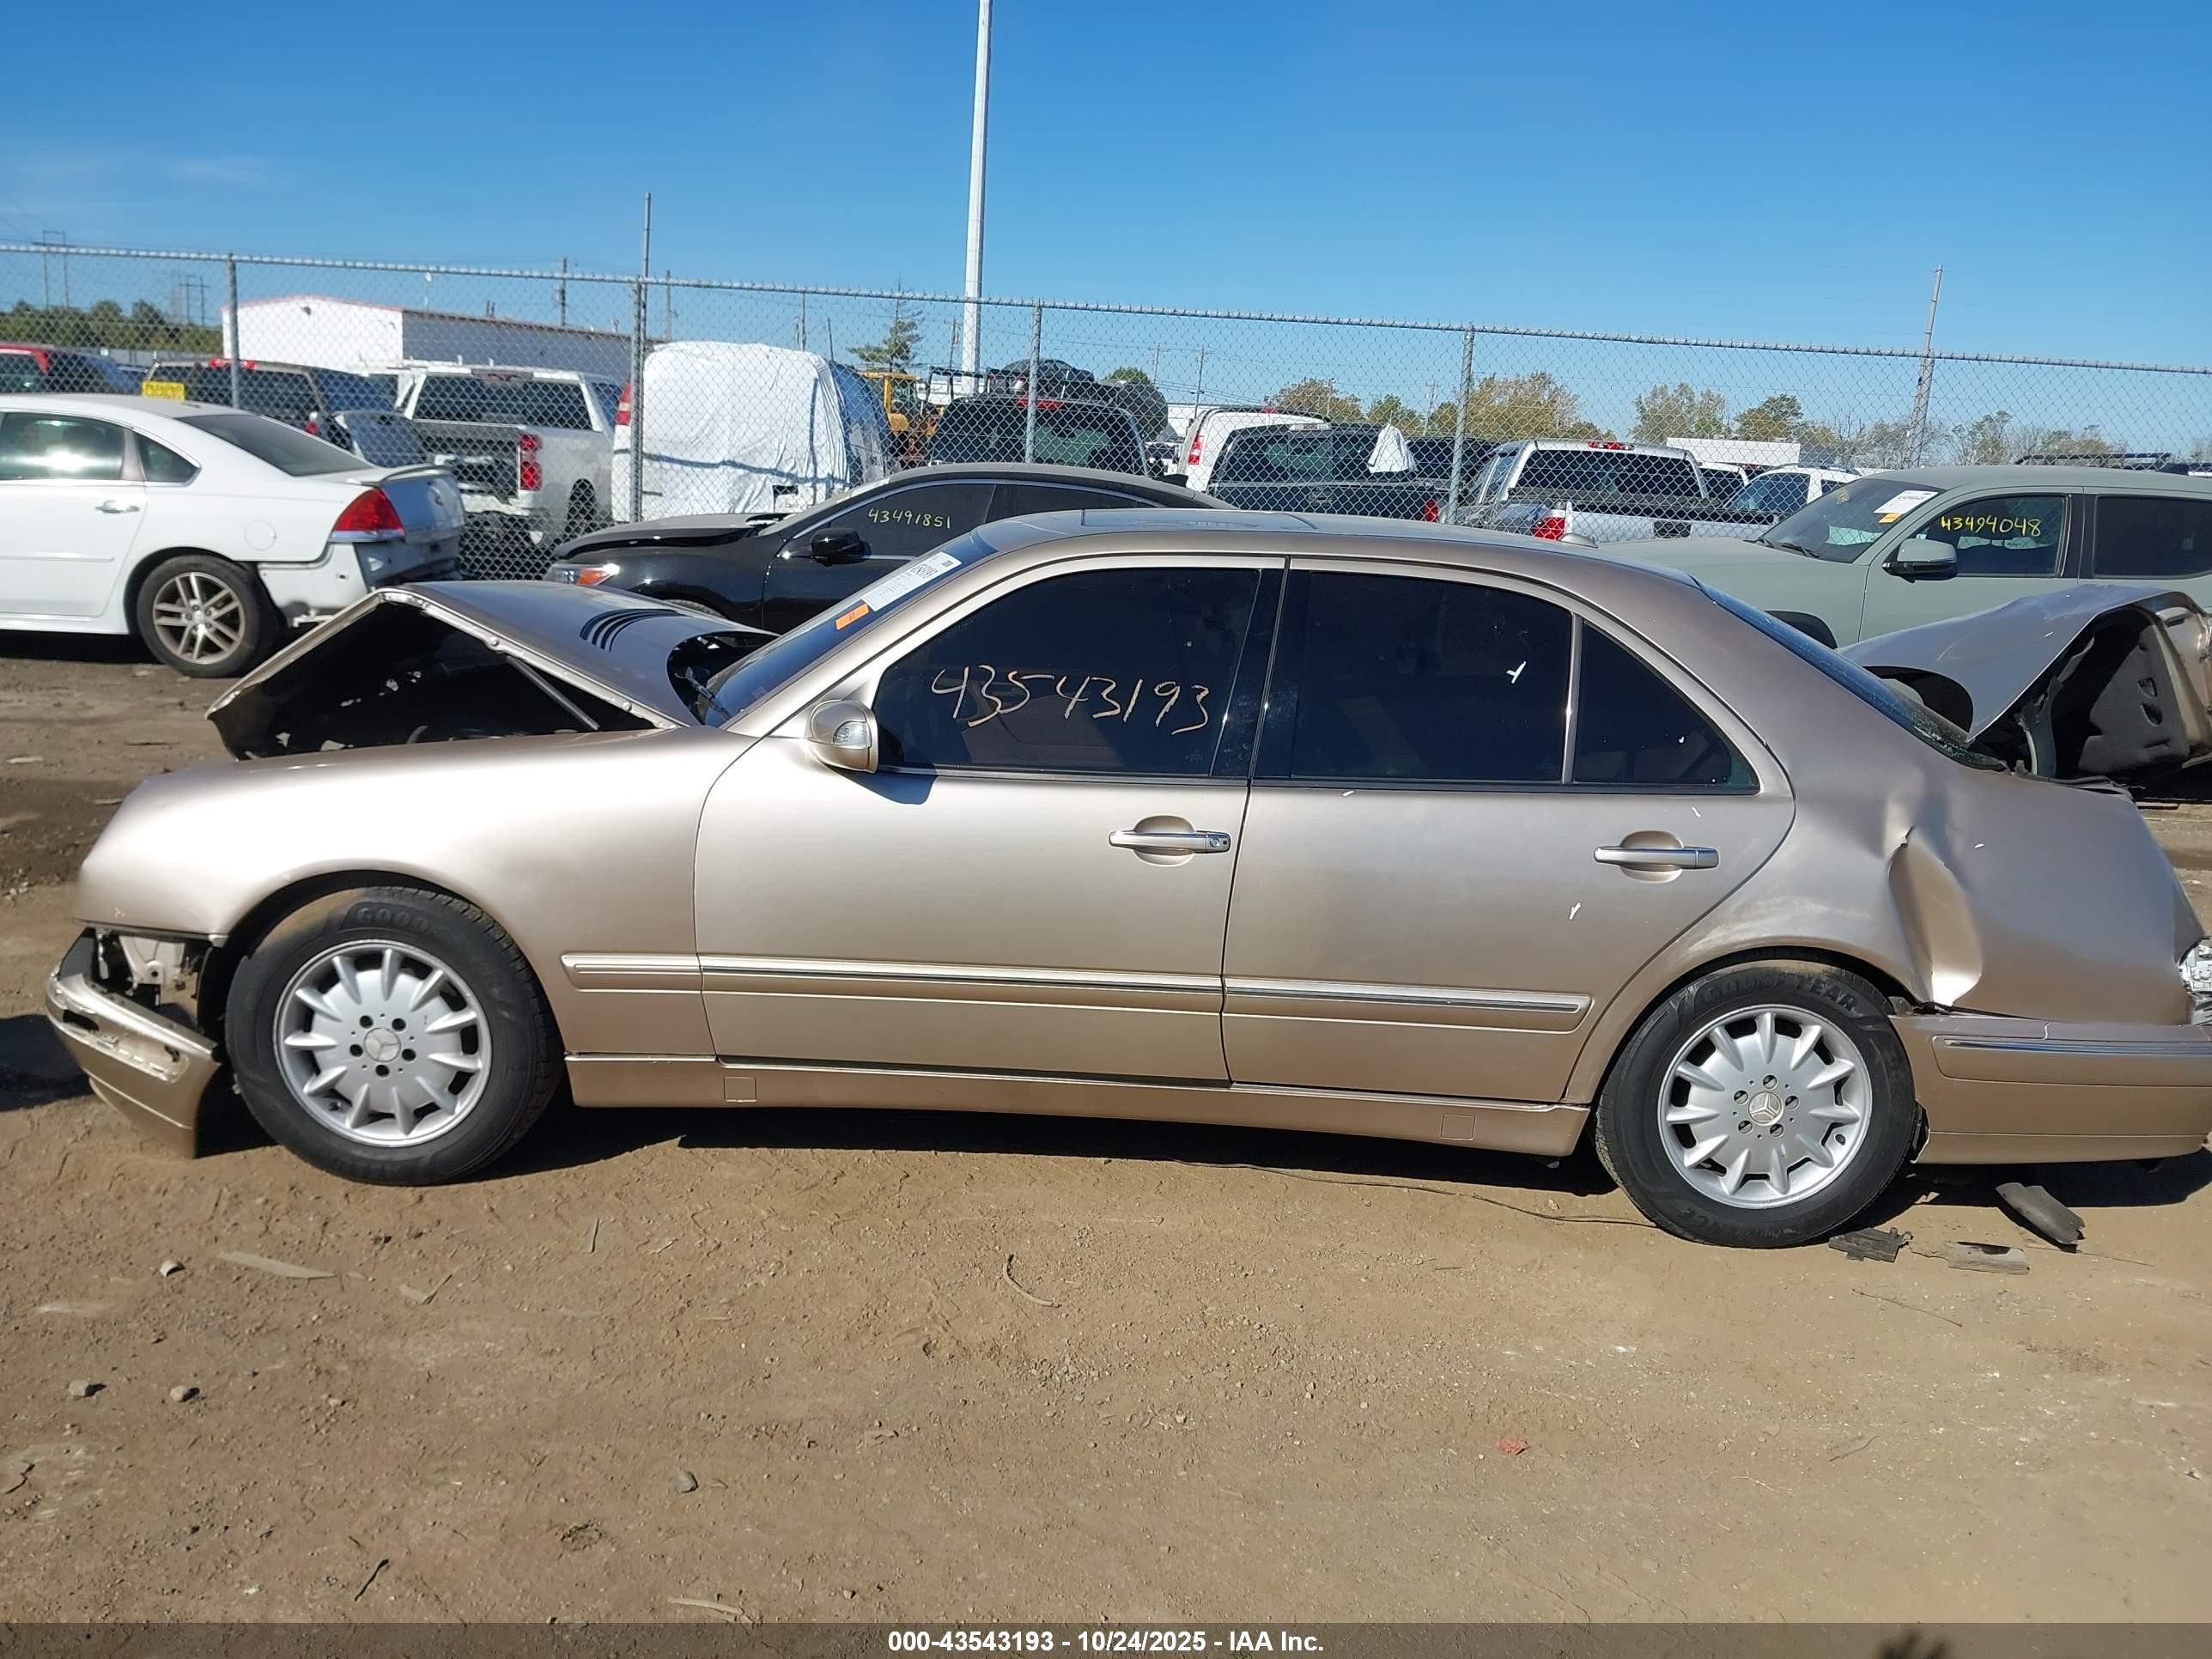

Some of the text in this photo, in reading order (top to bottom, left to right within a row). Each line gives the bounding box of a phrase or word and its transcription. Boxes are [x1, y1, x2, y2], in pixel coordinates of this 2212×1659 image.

[868, 507, 951, 529] 43491851
[1941, 514, 2042, 537] 43494048
[932, 665, 1210, 735] 43543193
